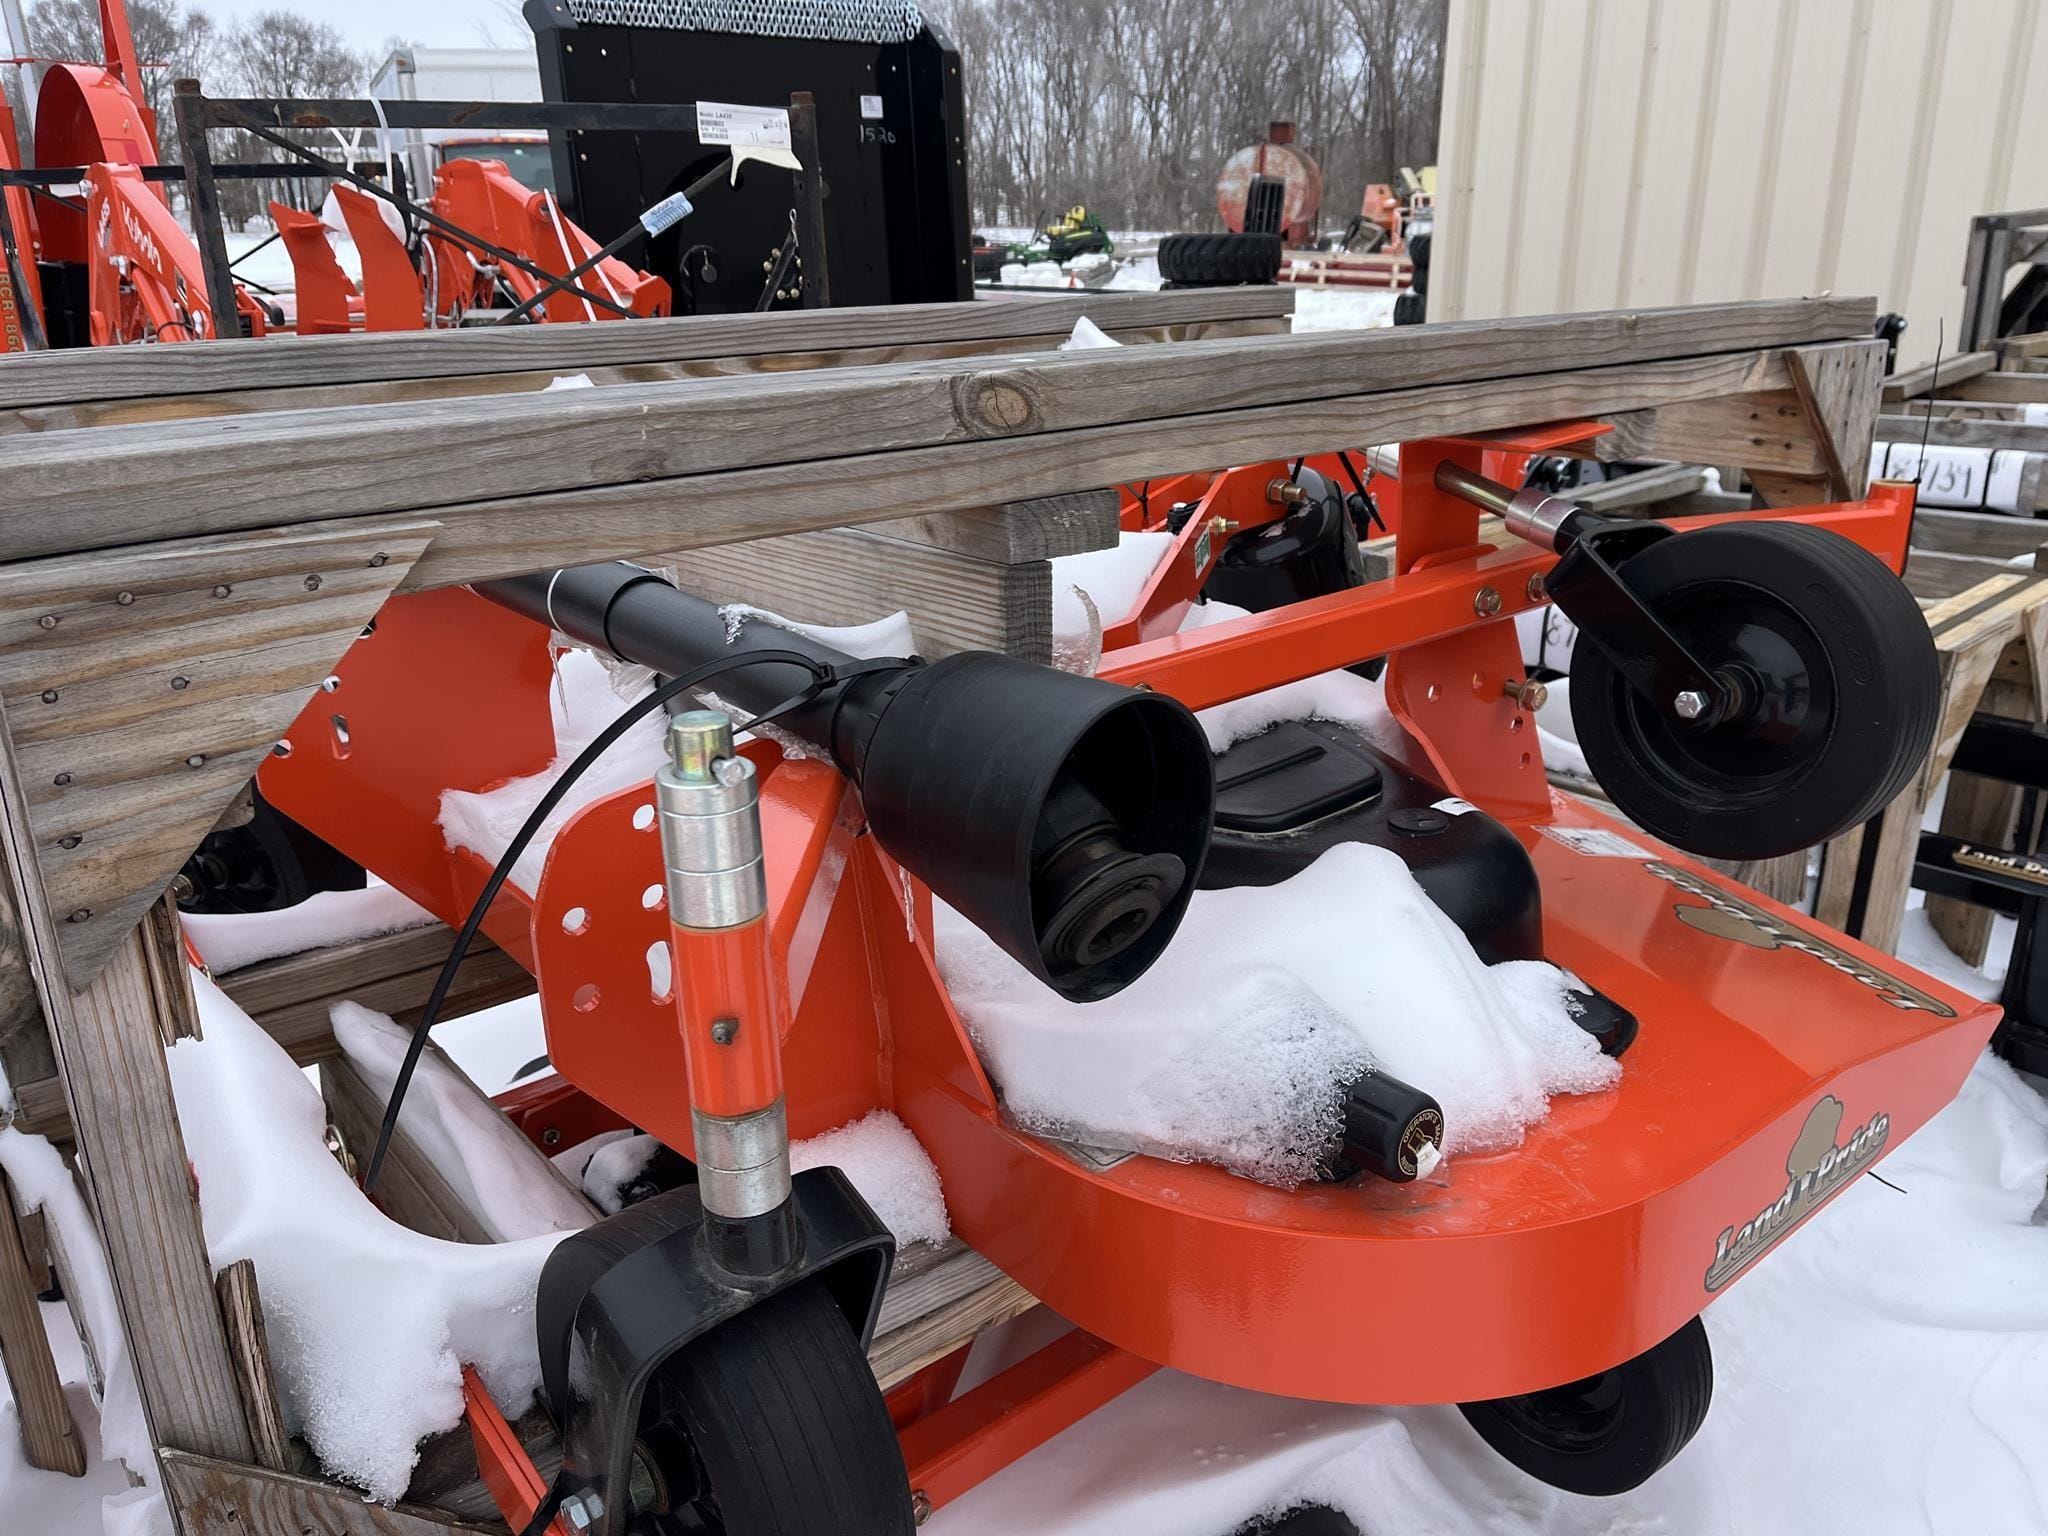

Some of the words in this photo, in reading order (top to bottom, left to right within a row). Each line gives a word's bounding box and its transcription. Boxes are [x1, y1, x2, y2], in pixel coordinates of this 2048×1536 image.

[121, 200, 164, 275] Kubota
[1708, 1177, 1803, 1279] Land
[1807, 1112, 1891, 1203] Pride
